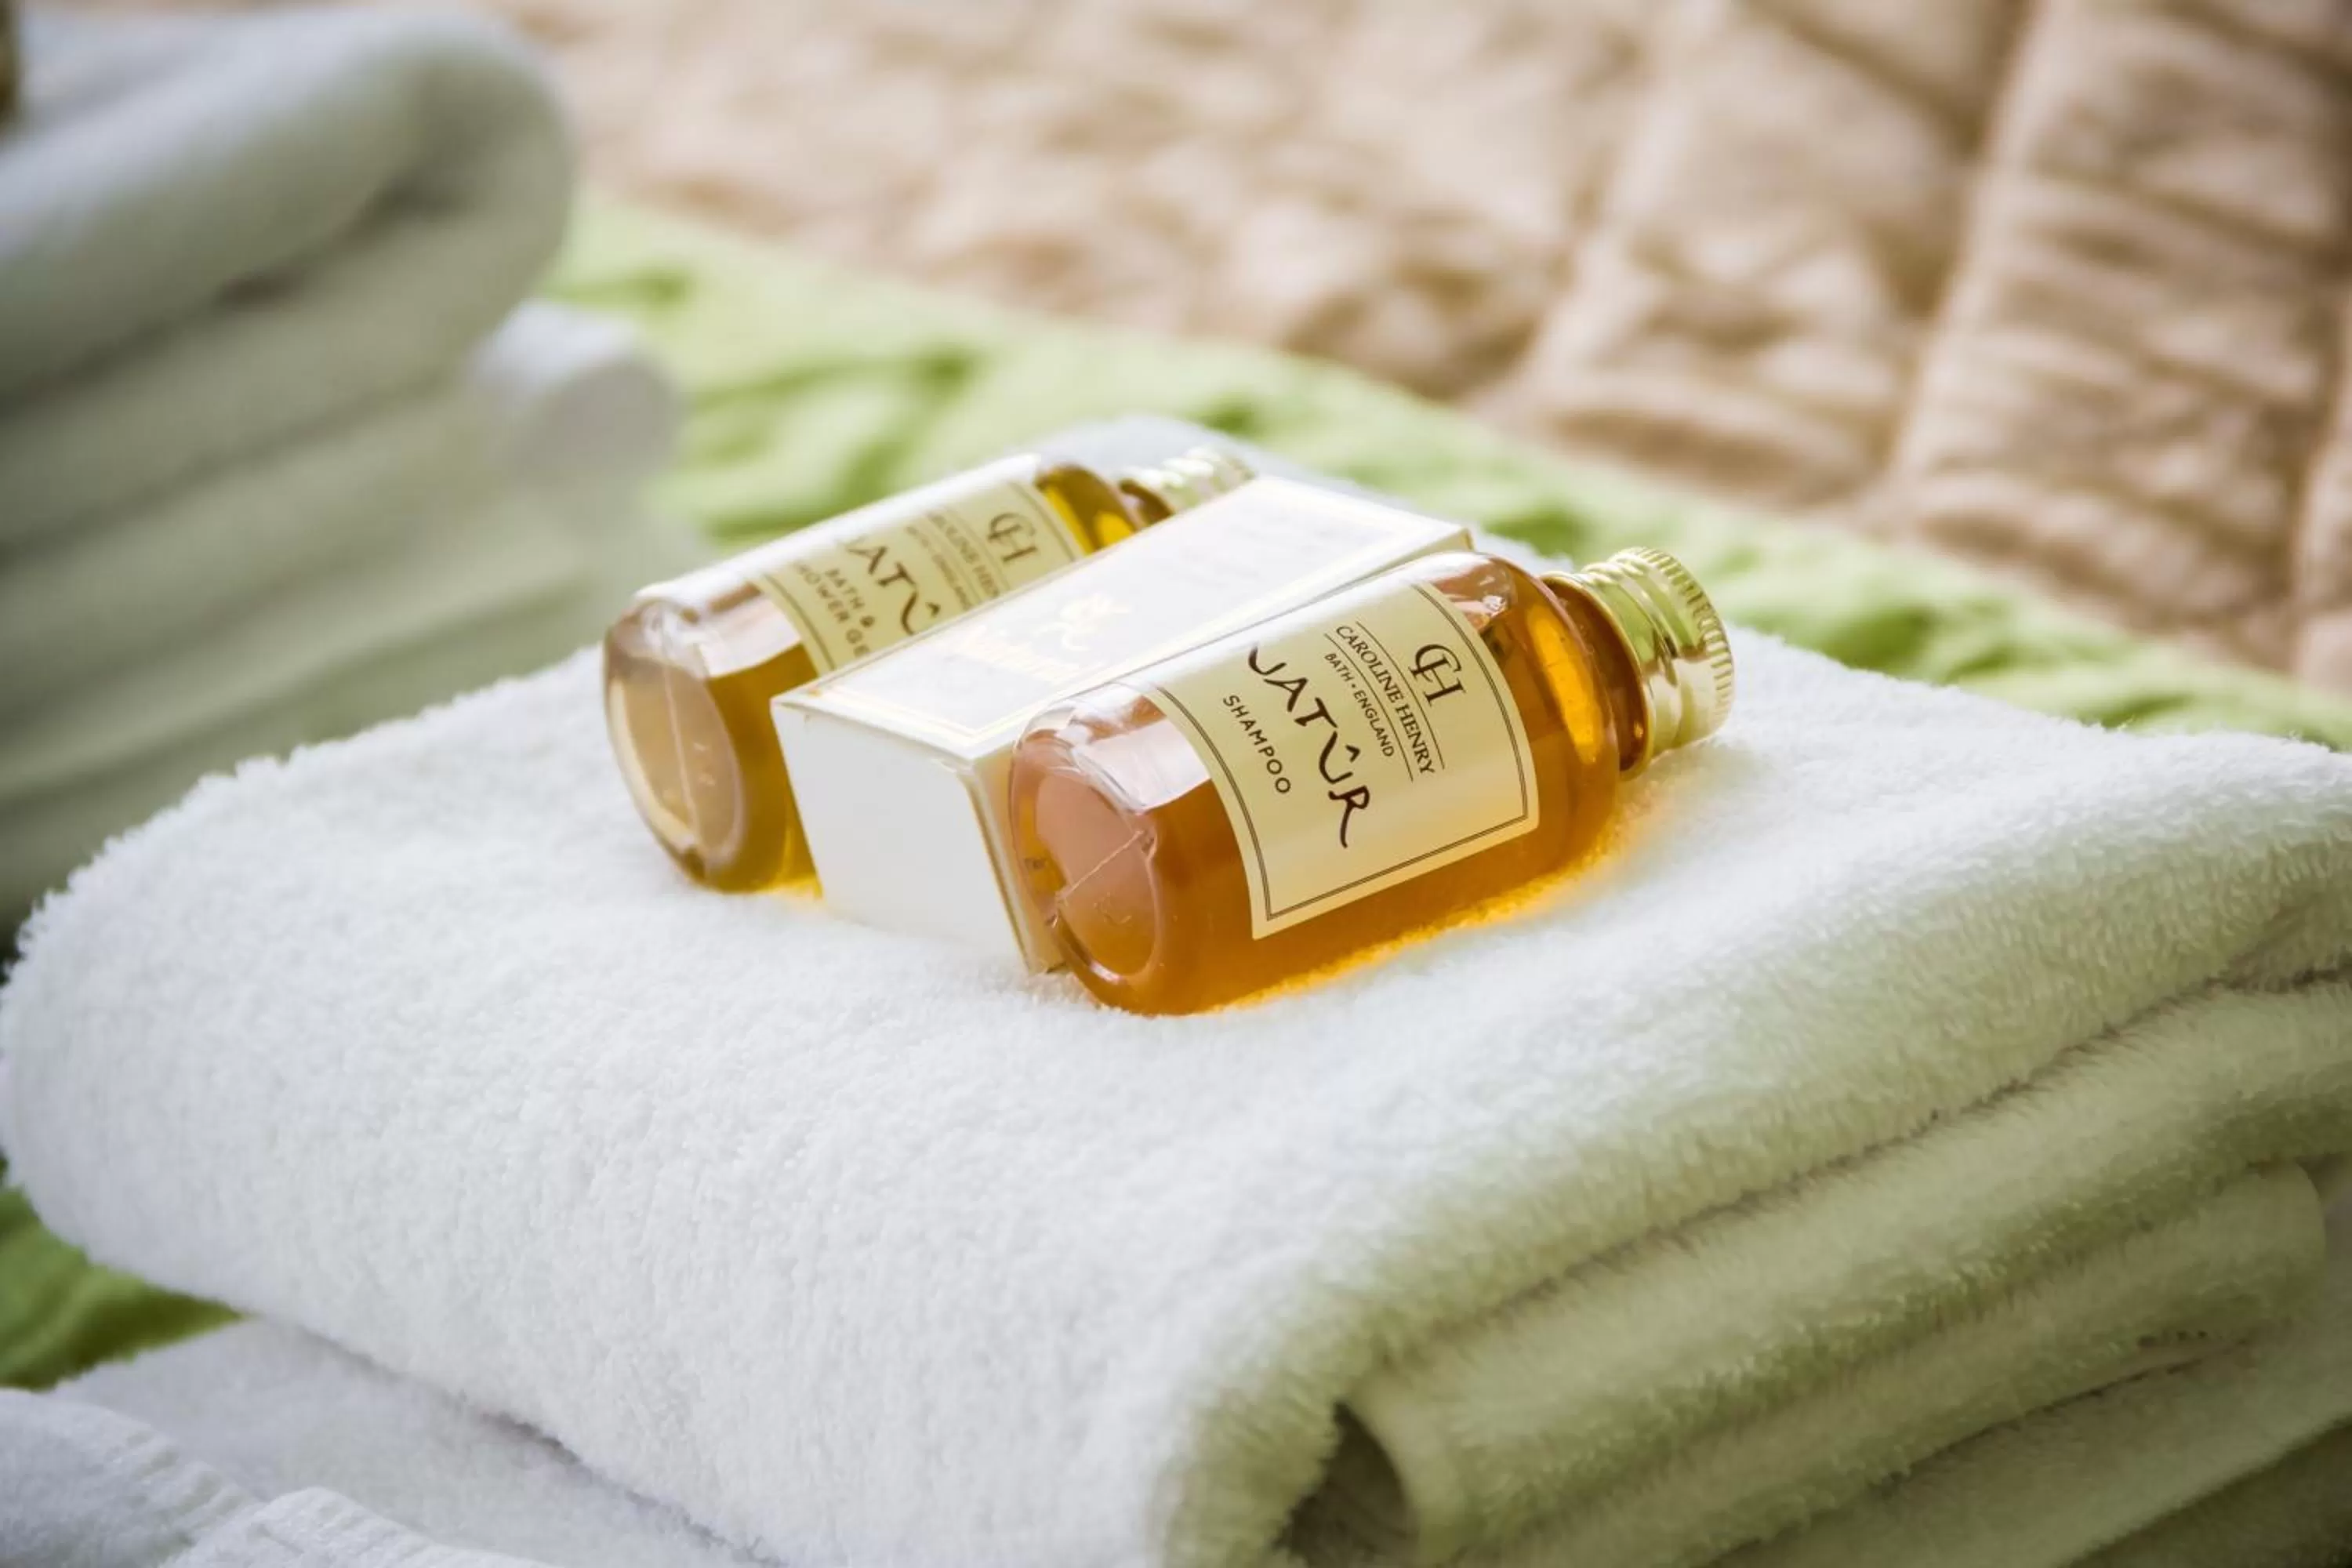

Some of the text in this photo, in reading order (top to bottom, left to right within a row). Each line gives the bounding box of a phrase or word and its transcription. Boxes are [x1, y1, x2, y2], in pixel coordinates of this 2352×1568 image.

[793, 559, 872, 659] OWER GE
[1222, 694, 1292, 794] SHAMPOO
[1323, 652, 1395, 757] BATH ENGLAND
[1335, 625, 1436, 774] CAROLINE HENRY
